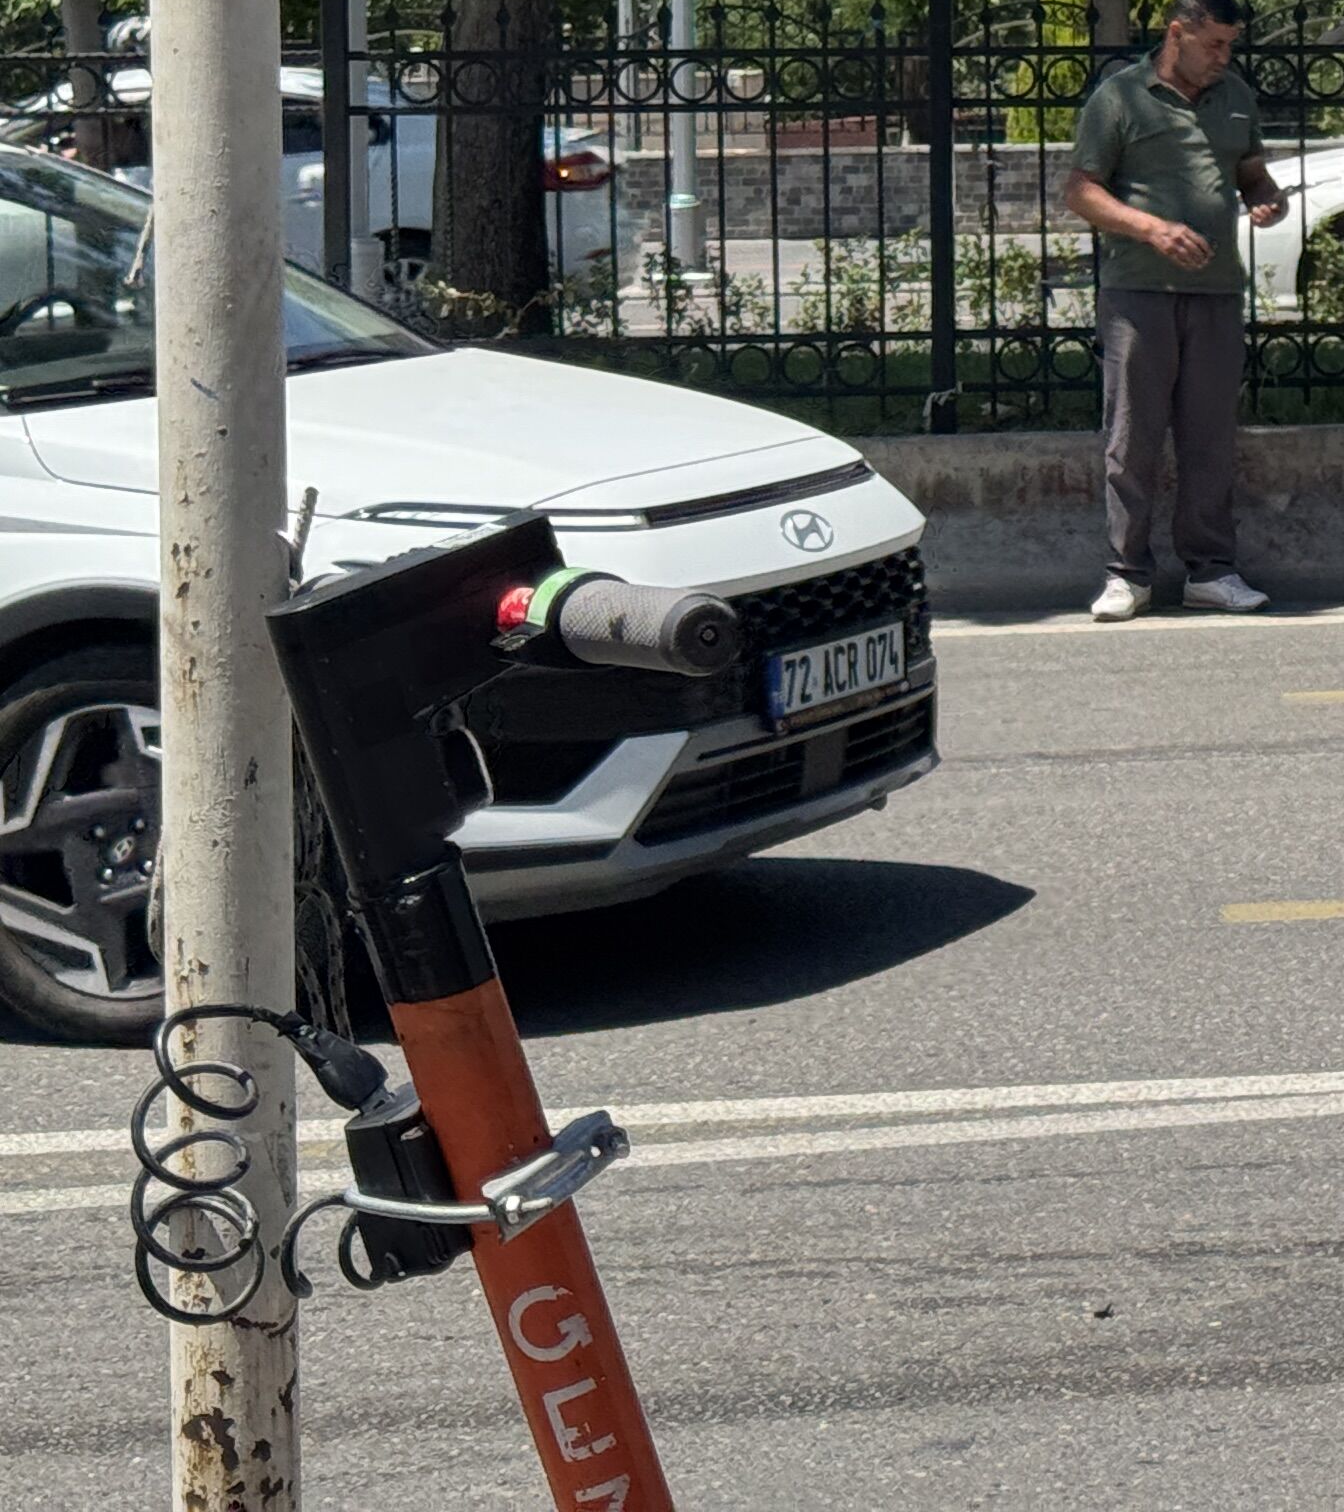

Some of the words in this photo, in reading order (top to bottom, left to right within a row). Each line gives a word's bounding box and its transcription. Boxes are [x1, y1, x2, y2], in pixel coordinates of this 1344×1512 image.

[783, 654, 813, 709] 72
[823, 640, 859, 697] ACR
[865, 629, 899, 682] 074
